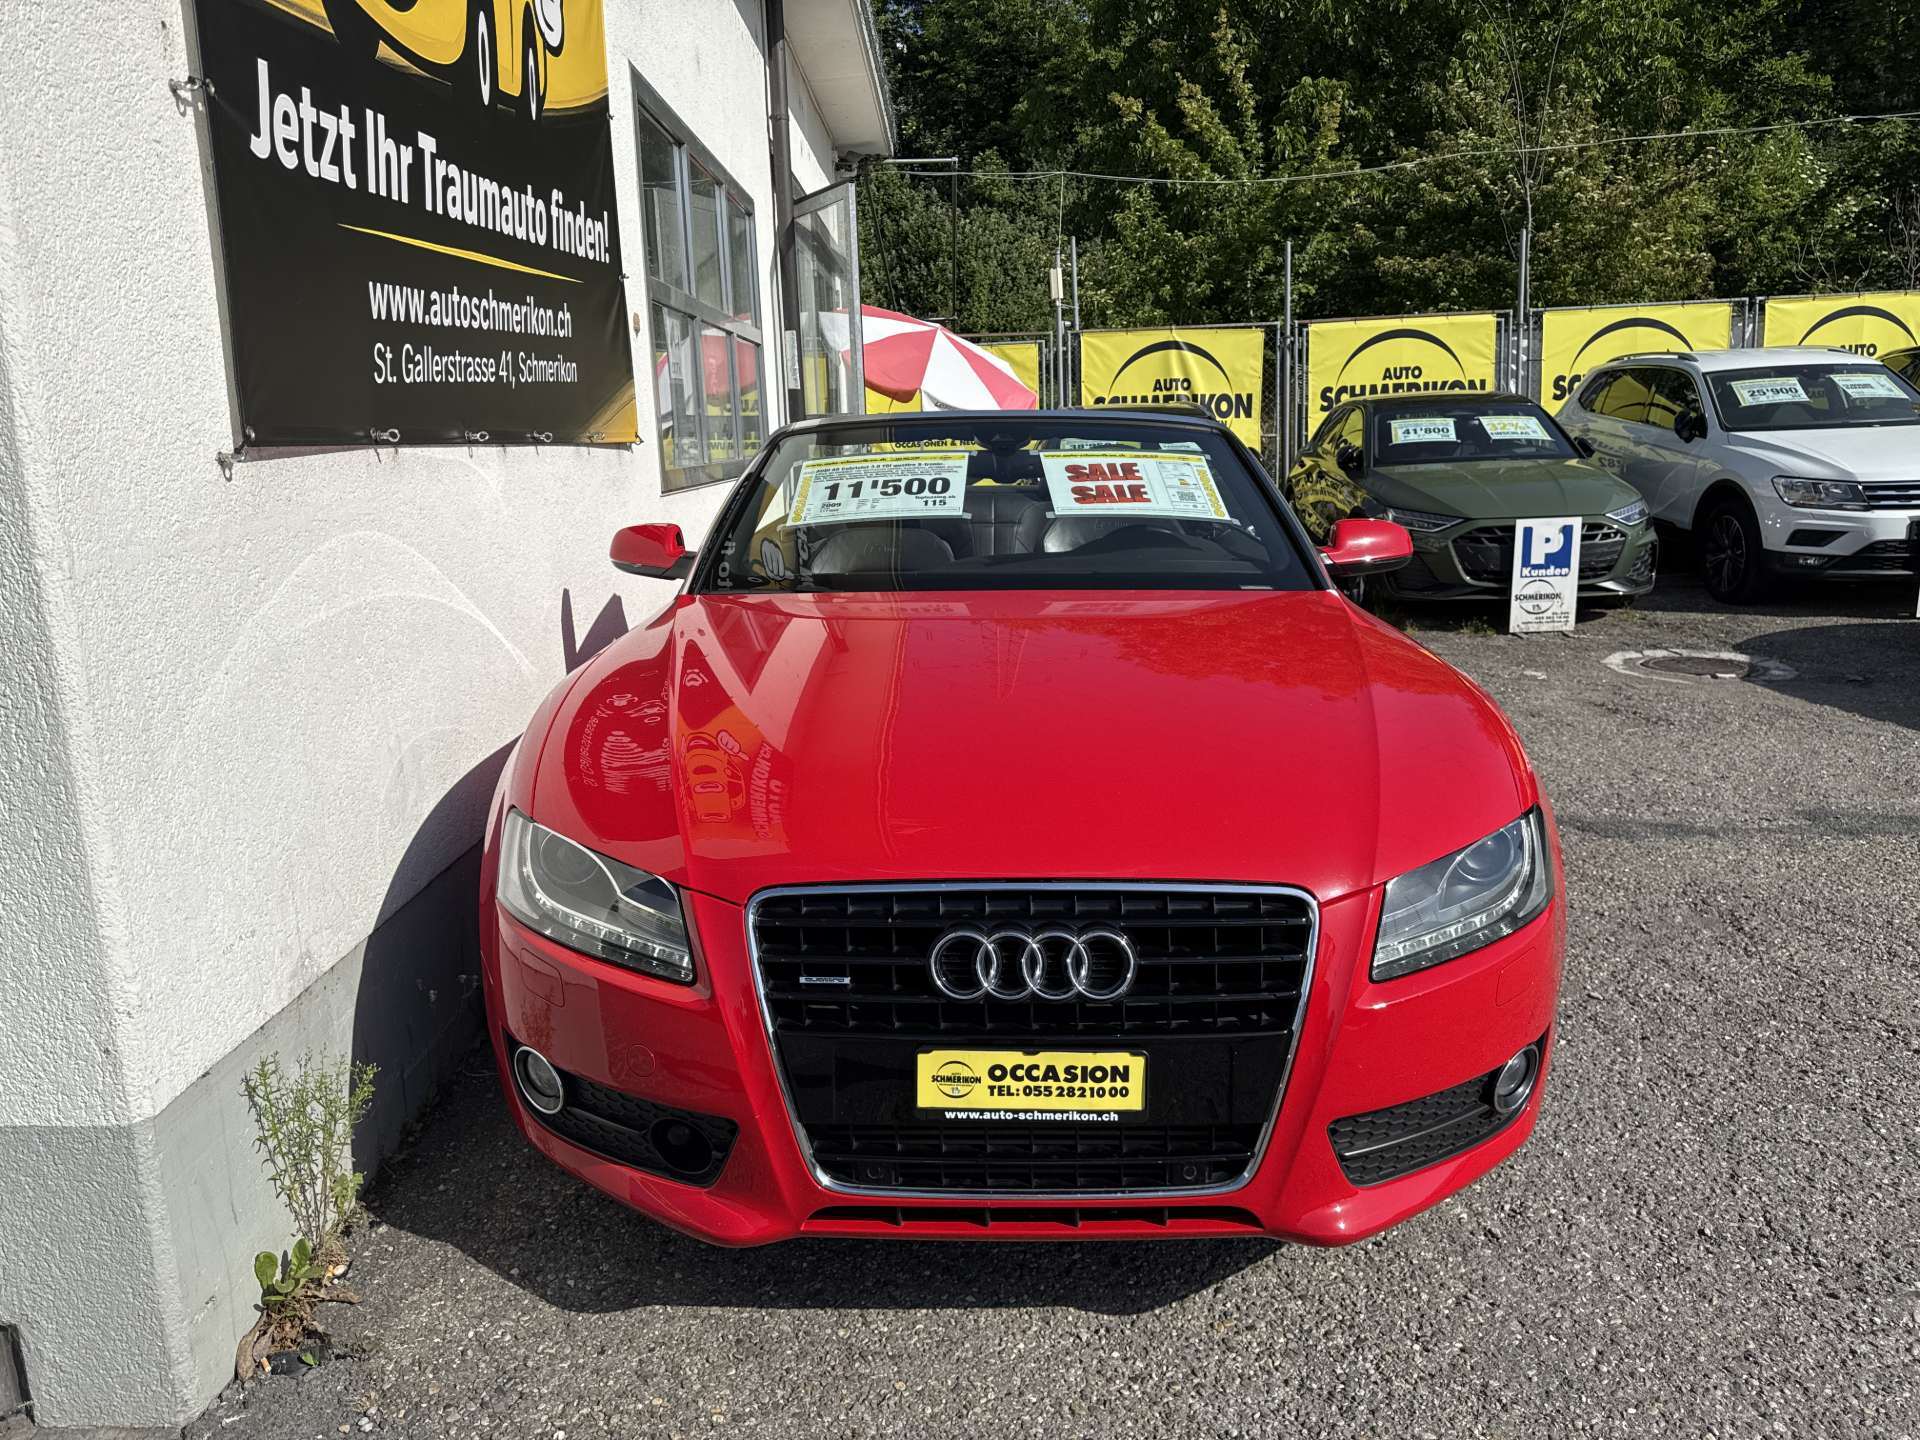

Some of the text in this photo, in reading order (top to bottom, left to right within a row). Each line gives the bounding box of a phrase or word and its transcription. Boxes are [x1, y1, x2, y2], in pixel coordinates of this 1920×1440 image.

[250, 58, 610, 264] Jetzt Ihr Traumauto finden!
[369, 280, 572, 339] www.autoschmerikon.ch
[374, 343, 578, 389] St. Gallerstrasse 41, Schmerikon
[1382, 366, 1423, 381] AUTO
[1152, 377, 1192, 392] AUTO
[1748, 386, 1799, 397] 25'900
[1402, 427, 1450, 436] 41'800
[1065, 462, 1143, 482] SALE
[824, 477, 950, 501] 11'500
[1071, 484, 1152, 505] SALE
[1530, 524, 1564, 565] P
[1521, 566, 1570, 577] Kunden
[1514, 592, 1561, 602] SCHMERIKON
[931, 1074, 981, 1084] SCHMERIKON
[988, 1064, 1130, 1083] OCCASION
[988, 1085, 1129, 1098] TEL: 055 282 10 00
[944, 1110, 1119, 1123] www.auto-schmerikon.ch
